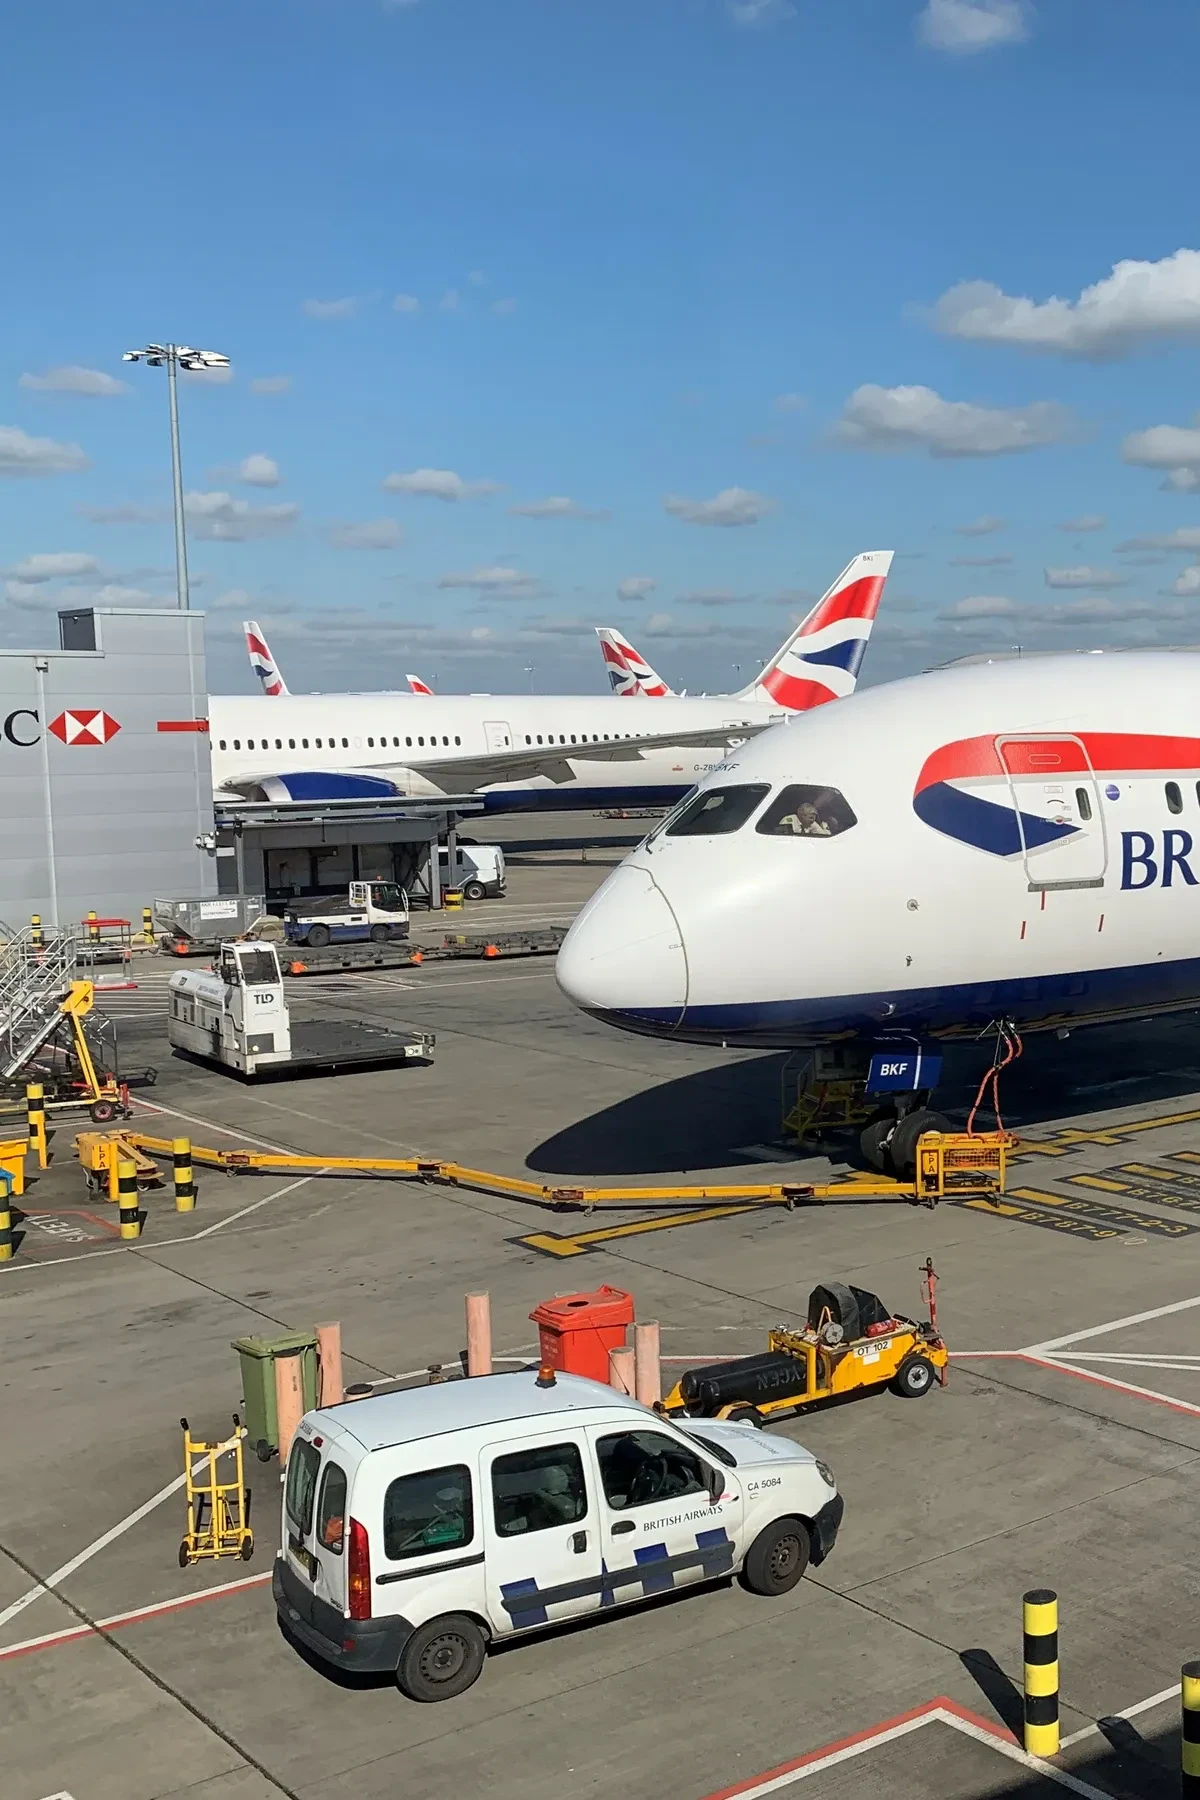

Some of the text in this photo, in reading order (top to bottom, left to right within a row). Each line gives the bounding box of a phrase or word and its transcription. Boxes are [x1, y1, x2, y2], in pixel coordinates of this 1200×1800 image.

[0, 709, 41, 747] C
[253, 993, 275, 1005] TLD
[880, 1063, 908, 1076] BKF
[98, 1145, 106, 1169] LPA
[1019, 1212, 1118, 1238] B787-9
[1063, 1202, 1189, 1235] B777-2-3
[857, 1340, 889, 1357] OT 102
[747, 1477, 782, 1492] CA 5084
[643, 1504, 723, 1532] BRITISH AIRWAYS
